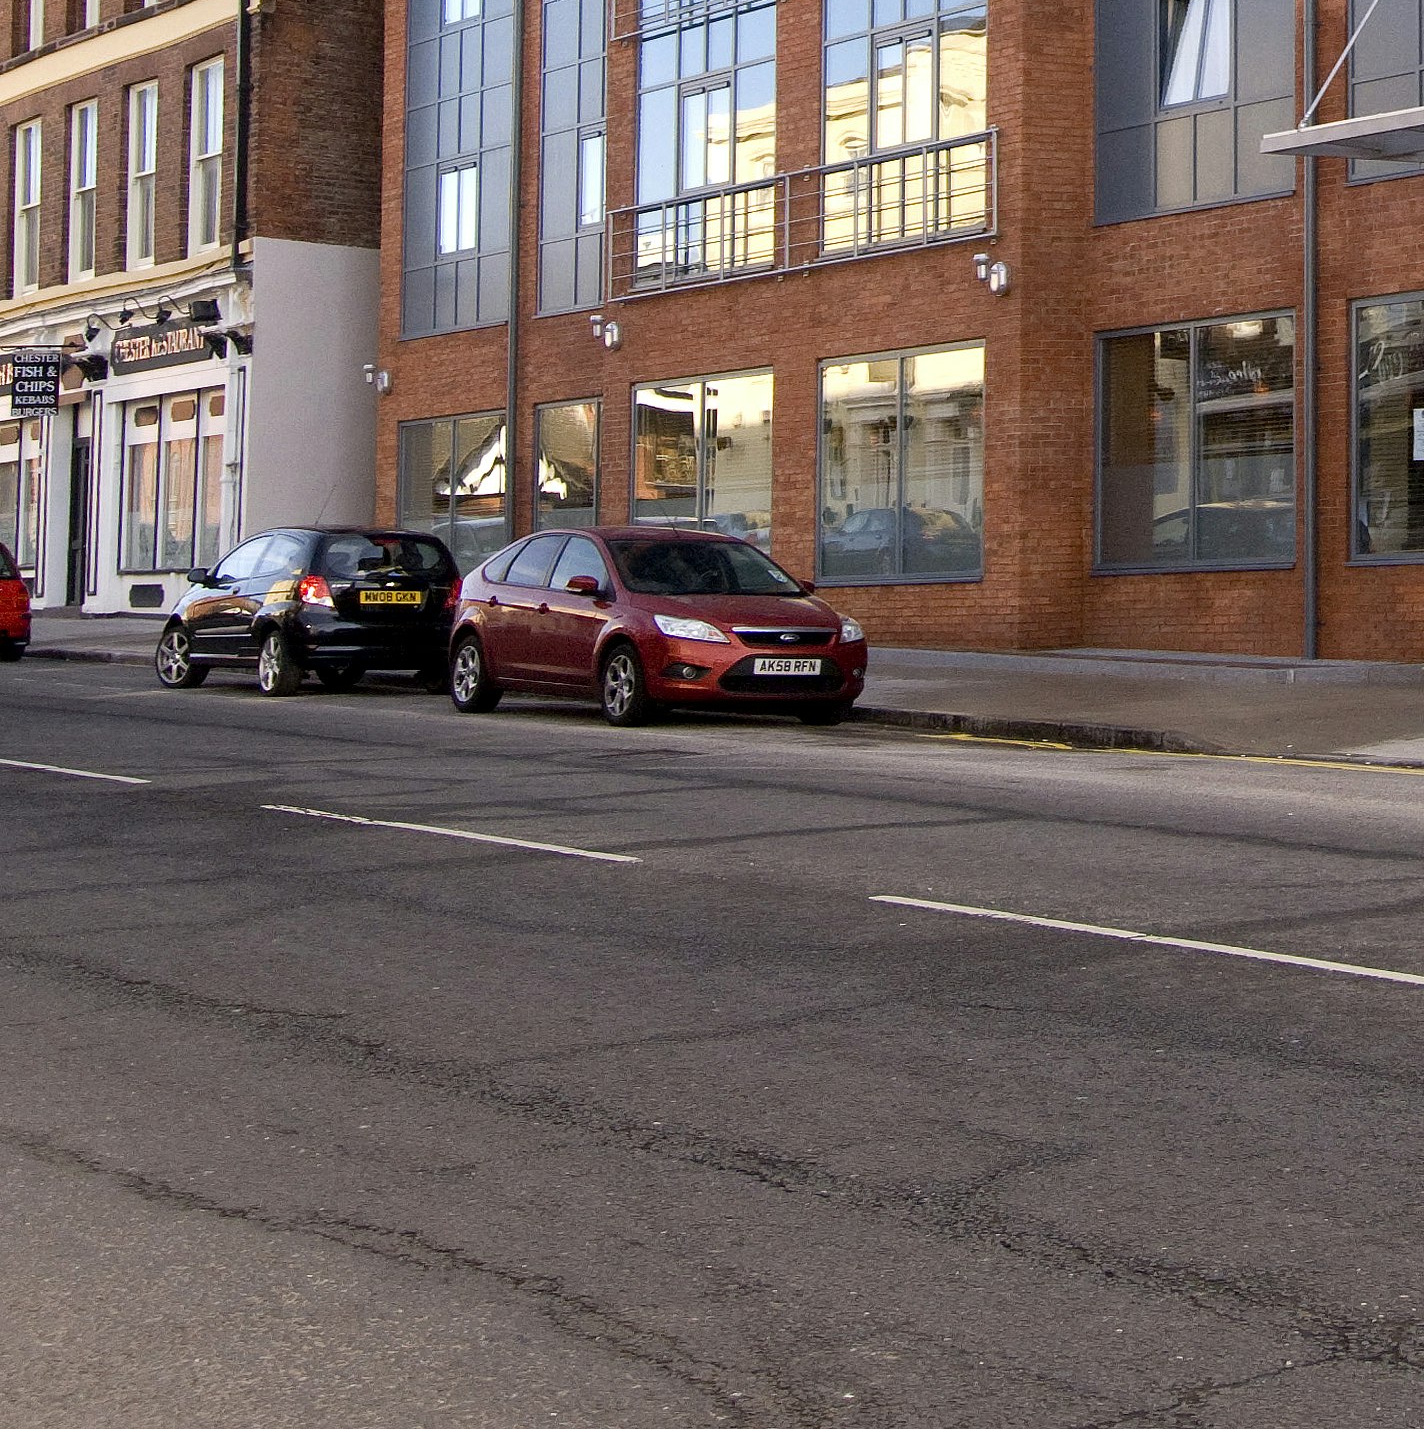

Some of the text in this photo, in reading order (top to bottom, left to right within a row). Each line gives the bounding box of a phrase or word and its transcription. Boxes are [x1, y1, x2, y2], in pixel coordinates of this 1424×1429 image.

[14, 354, 59, 363] CHESTER
[14, 366, 43, 377] FISH
[47, 366, 57, 377] &
[16, 381, 55, 392] CHIPS
[15, 395, 55, 405] KEBABS
[12, 407, 57, 416] BURGERS
[760, 660, 817, 672] AK58 RFN
